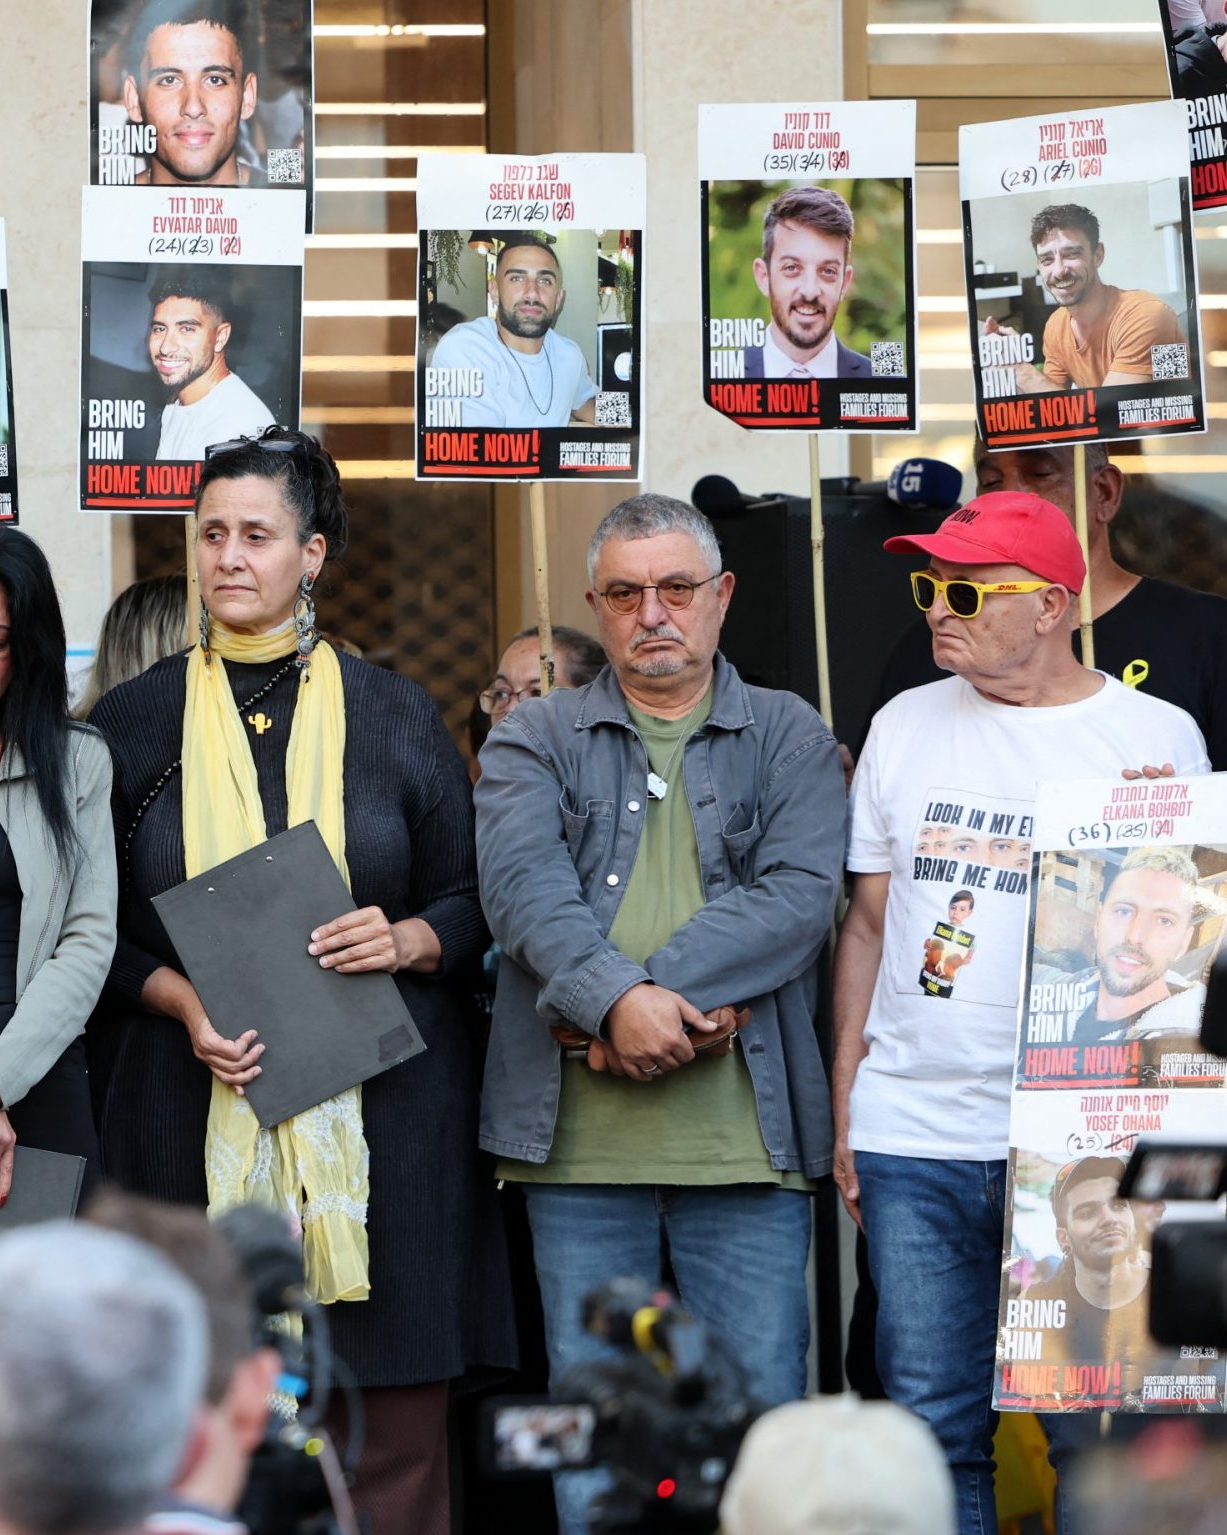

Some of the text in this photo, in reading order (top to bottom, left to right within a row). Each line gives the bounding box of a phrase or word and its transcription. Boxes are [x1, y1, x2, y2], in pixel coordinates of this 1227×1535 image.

[785, 113, 830, 131] דוד קוניו
[1039, 119, 1104, 142] אריאל קוניו
[100, 125, 157, 155] BRING
[773, 132, 840, 150] DAVID CUNIO
[1039, 138, 1107, 161] ARIEL CUNIO
[99, 156, 135, 184] HIM
[504, 164, 558, 182] שגב כלפון
[1001, 166, 1037, 192] (28)
[490, 183, 571, 200] SEGEV KALFON
[168, 198, 223, 215] אביתר דוד
[153, 217, 237, 234] EVYATAR DAVID
[710, 319, 765, 347] BRING
[710, 350, 744, 378] HIM
[978, 333, 1034, 367] BRING
[425, 368, 483, 398] BRING
[711, 380, 820, 413] HOME NOW!
[982, 367, 1016, 399] HIM
[89, 399, 145, 429] BRING
[426, 400, 462, 427] HIM
[841, 403, 907, 417] FAMILIES FORUM
[984, 390, 1096, 432] HOME NOW!
[1119, 405, 1193, 424] FAMILIES FORUM
[89, 431, 123, 460] HIM
[425, 430, 540, 462] HOME NOW!
[88, 465, 140, 494] HOME
[902, 463, 923, 492] 15
[1112, 784, 1188, 802] אלקנה בוחבוט
[925, 802, 964, 825] LOOK
[967, 808, 986, 831] IN
[989, 814, 1015, 835] MY
[1103, 801, 1193, 821] ELKANA BOHBOT
[1069, 822, 1111, 846] (36)
[913, 857, 958, 882] BRING
[962, 864, 991, 888] ME
[1030, 984, 1087, 1012] BRING
[1027, 1015, 1063, 1043] HIM
[1025, 1041, 1140, 1076] HOME NOW!
[1081, 1095, 1169, 1112] יוסף חיים אוחנה
[1086, 1115, 1161, 1131] YOSEF OHANA
[1007, 1299, 1066, 1328] BRING
[1005, 1331, 1042, 1360] HIM
[1002, 1360, 1121, 1395] HOME NOW!
[1143, 1386, 1216, 1400] FAMILIES FORUM
